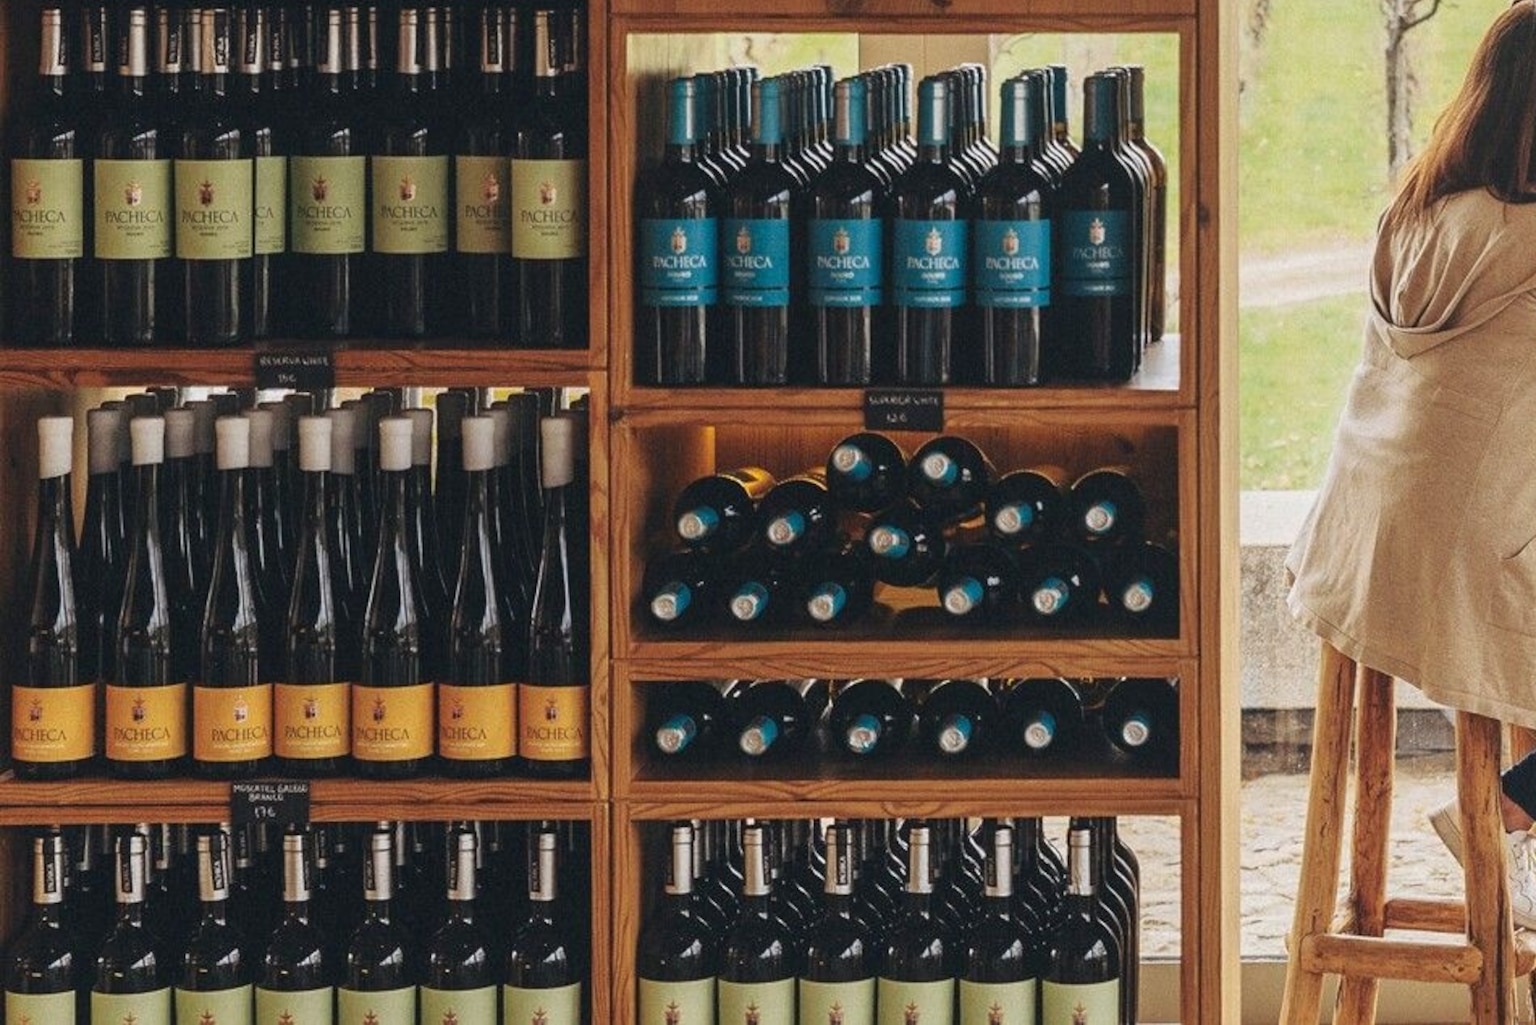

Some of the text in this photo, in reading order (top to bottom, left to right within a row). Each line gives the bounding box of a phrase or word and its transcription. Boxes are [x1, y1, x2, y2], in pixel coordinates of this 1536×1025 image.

[105, 210, 164, 223] PACHECA
[182, 210, 239, 223] PACHECA
[297, 206, 352, 219] PACHECA
[380, 206, 438, 219] PACHECA
[653, 255, 707, 268] PACHECA
[817, 255, 870, 269] PACHECA
[906, 257, 960, 269] PACHECA
[985, 257, 1039, 269] PACHECA
[114, 726, 170, 740] PACHECA
[211, 725, 269, 741] PACHECA
[285, 725, 342, 740] PACHECA
[526, 726, 583, 741] PACHECA
[233, 784, 275, 793] MOSCATEL
[248, 793, 284, 802] BRANCO
